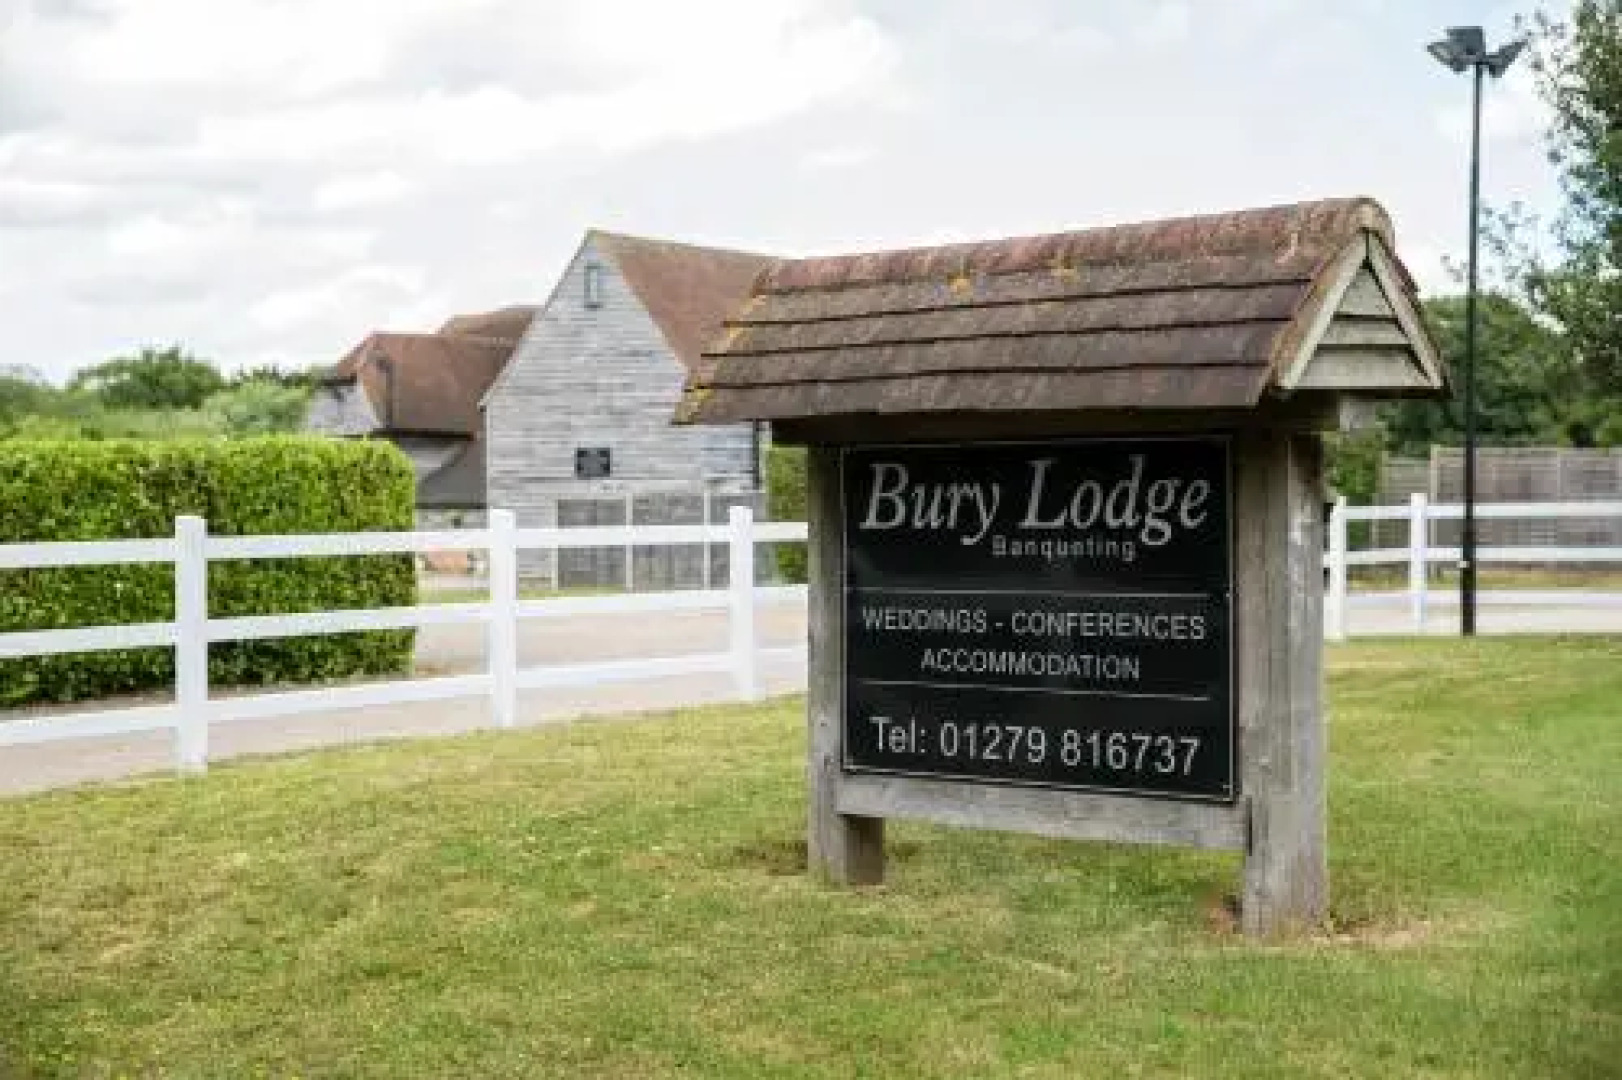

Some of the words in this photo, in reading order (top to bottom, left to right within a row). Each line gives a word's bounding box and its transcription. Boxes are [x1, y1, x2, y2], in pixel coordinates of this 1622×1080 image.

[859, 462, 1000, 546] Bury
[1017, 453, 1211, 546] Lodge
[862, 609, 987, 634] WEDDINGS
[1011, 612, 1206, 640] CONFERENCES
[920, 647, 1140, 681] ACCOMMODATION
[869, 715, 926, 754] Tel:
[940, 720, 1046, 763] 01279
[1060, 729, 1201, 776] 816737
